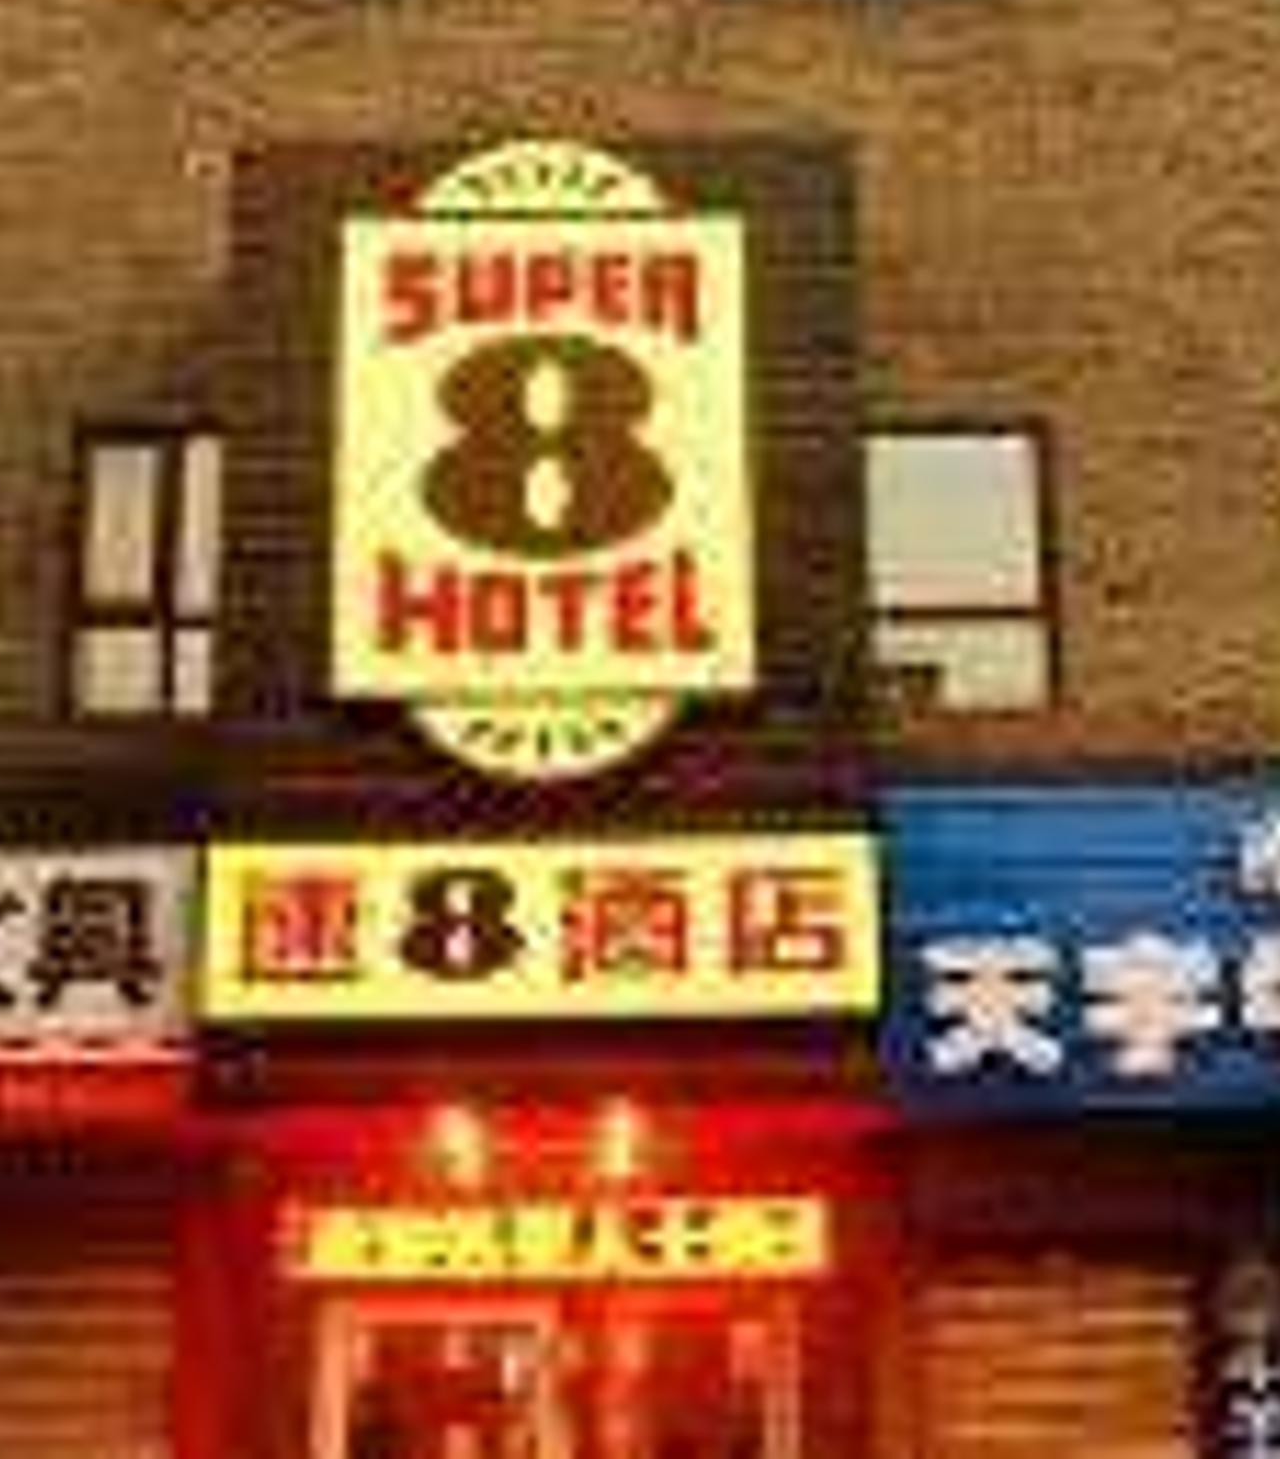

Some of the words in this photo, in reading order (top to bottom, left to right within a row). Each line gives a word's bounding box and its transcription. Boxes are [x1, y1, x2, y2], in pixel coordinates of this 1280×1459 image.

[380, 251, 700, 342] SUPER
[420, 334, 676, 560] 8
[374, 546, 718, 654] HOTEL
